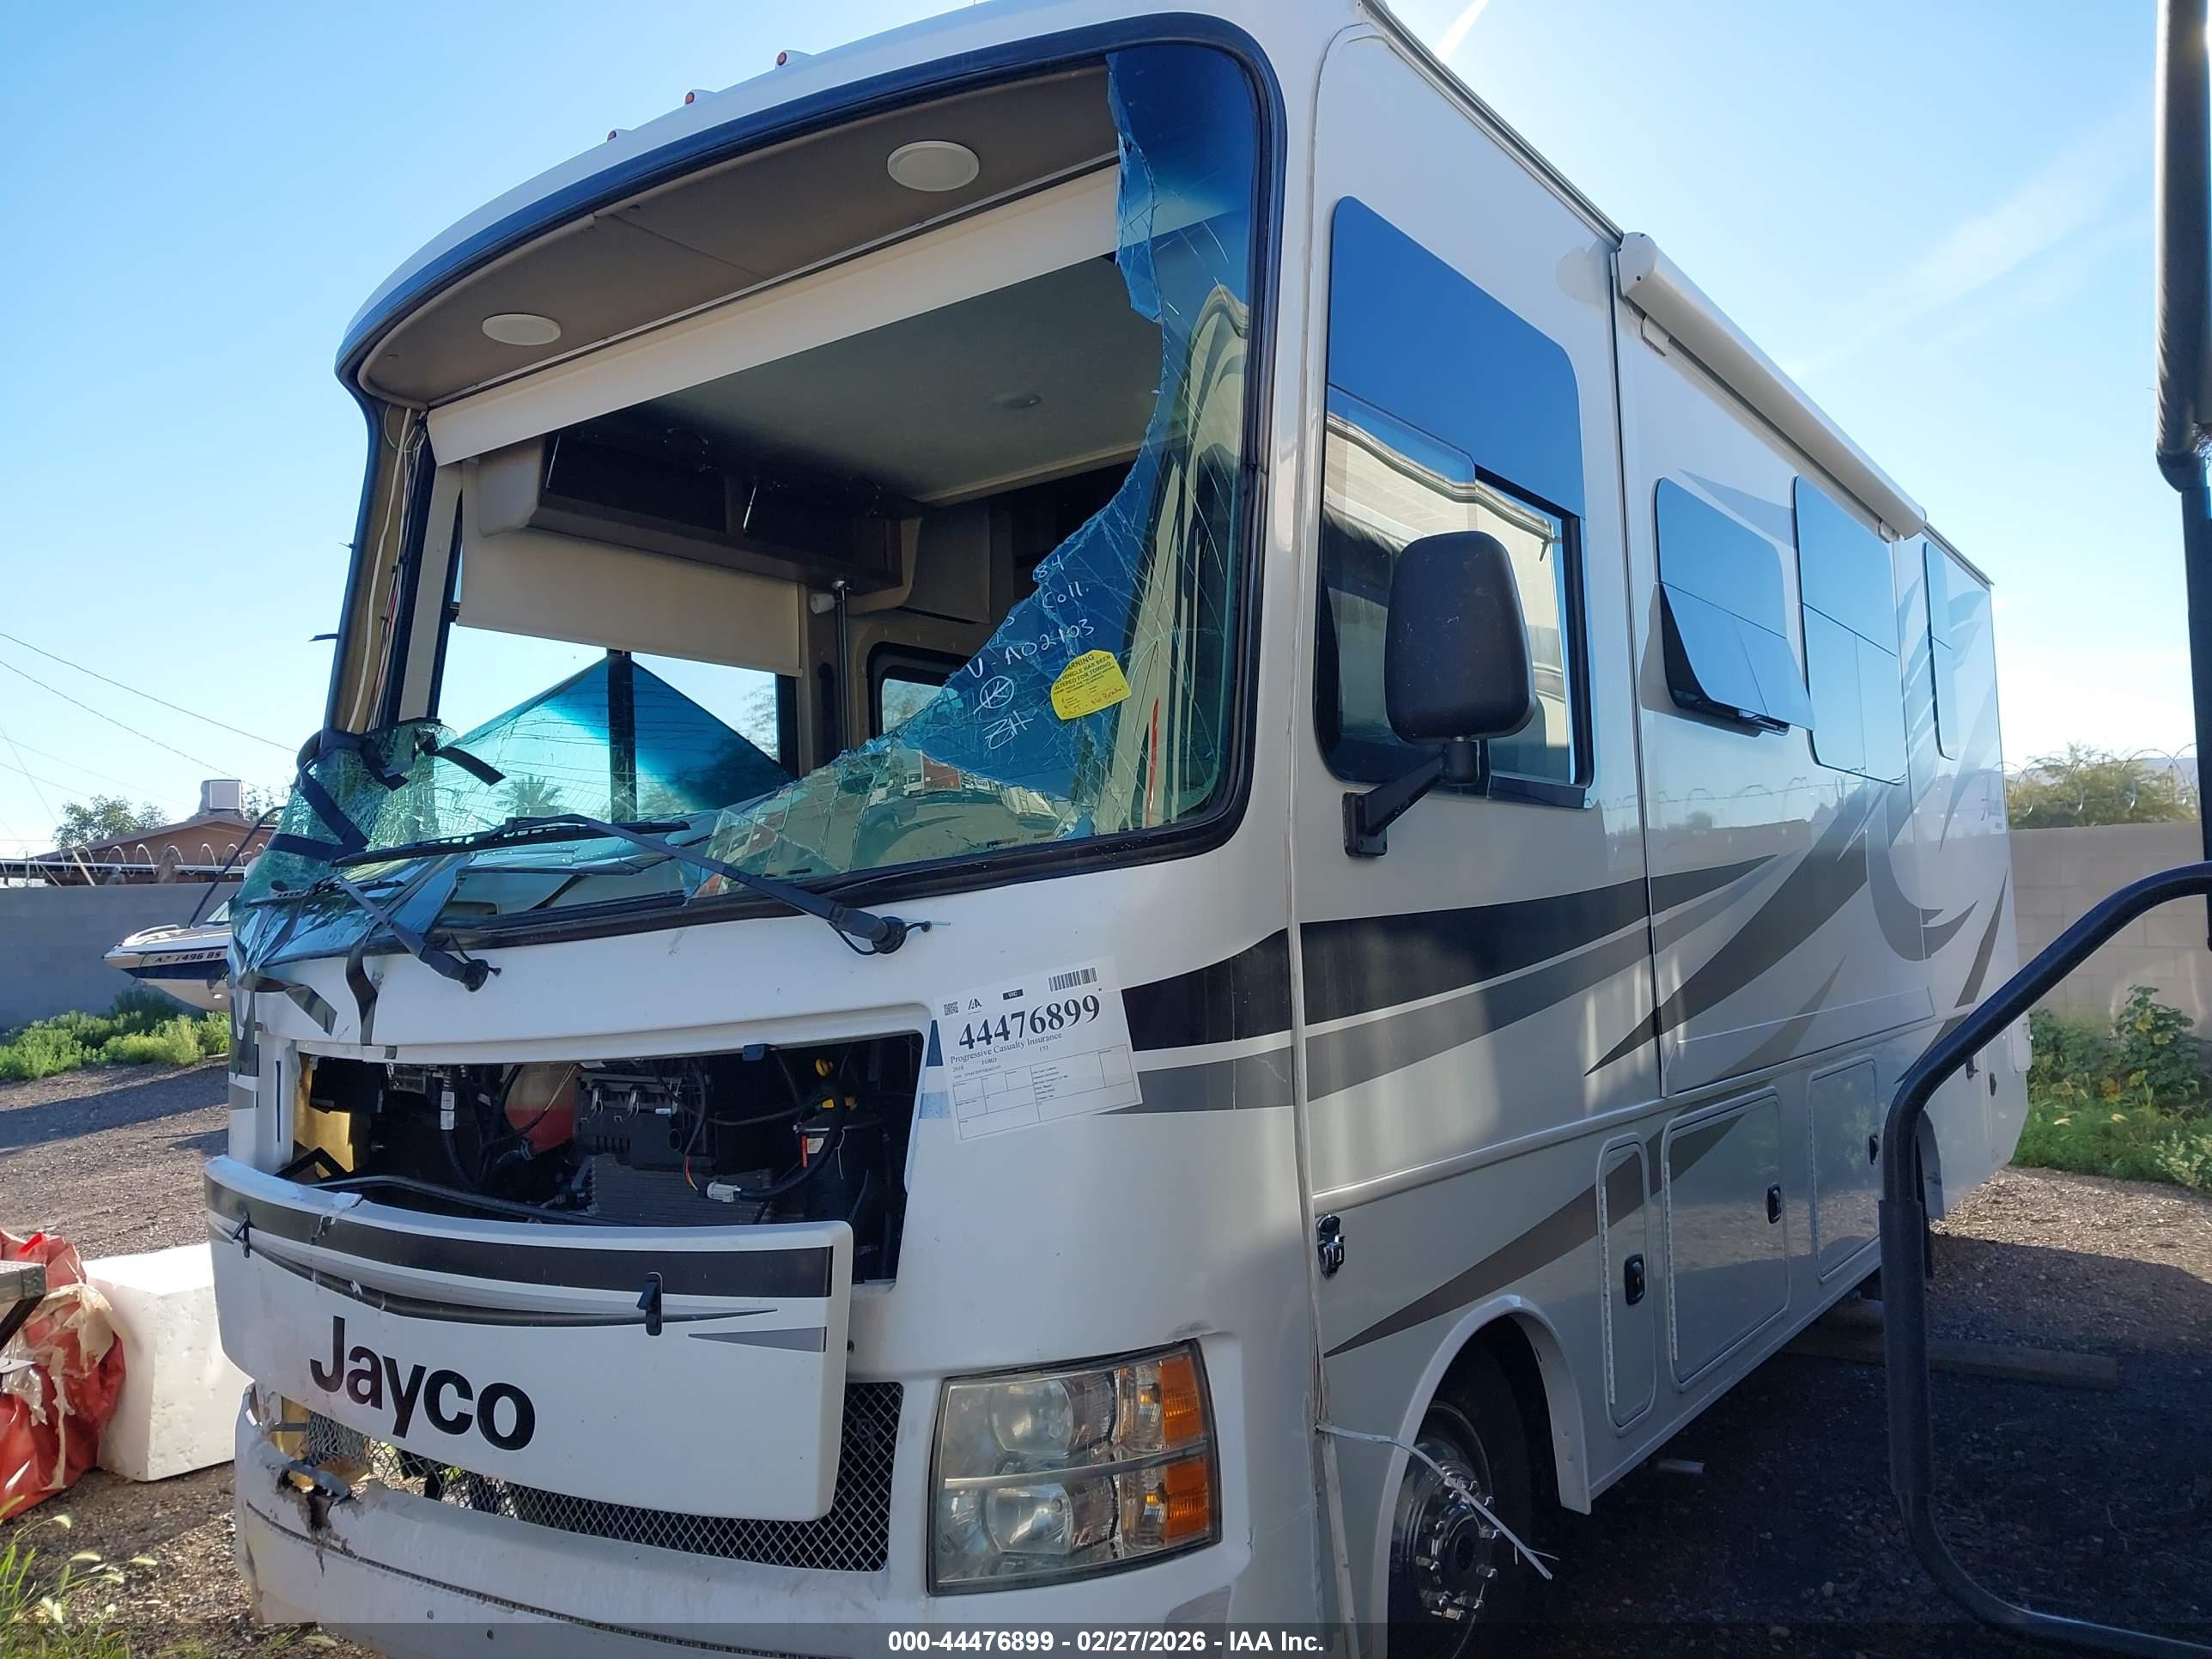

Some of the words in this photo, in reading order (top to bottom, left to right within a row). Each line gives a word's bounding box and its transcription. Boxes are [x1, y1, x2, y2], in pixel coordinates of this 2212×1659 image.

[1066, 653, 1095, 671] ARNING
[958, 994, 1100, 1049] 44476899
[950, 1048, 992, 1064] Progressive
[993, 1041, 1024, 1054] Casualty
[1027, 1032, 1063, 1046] Insurance
[309, 1315, 536, 1451] Jayco
